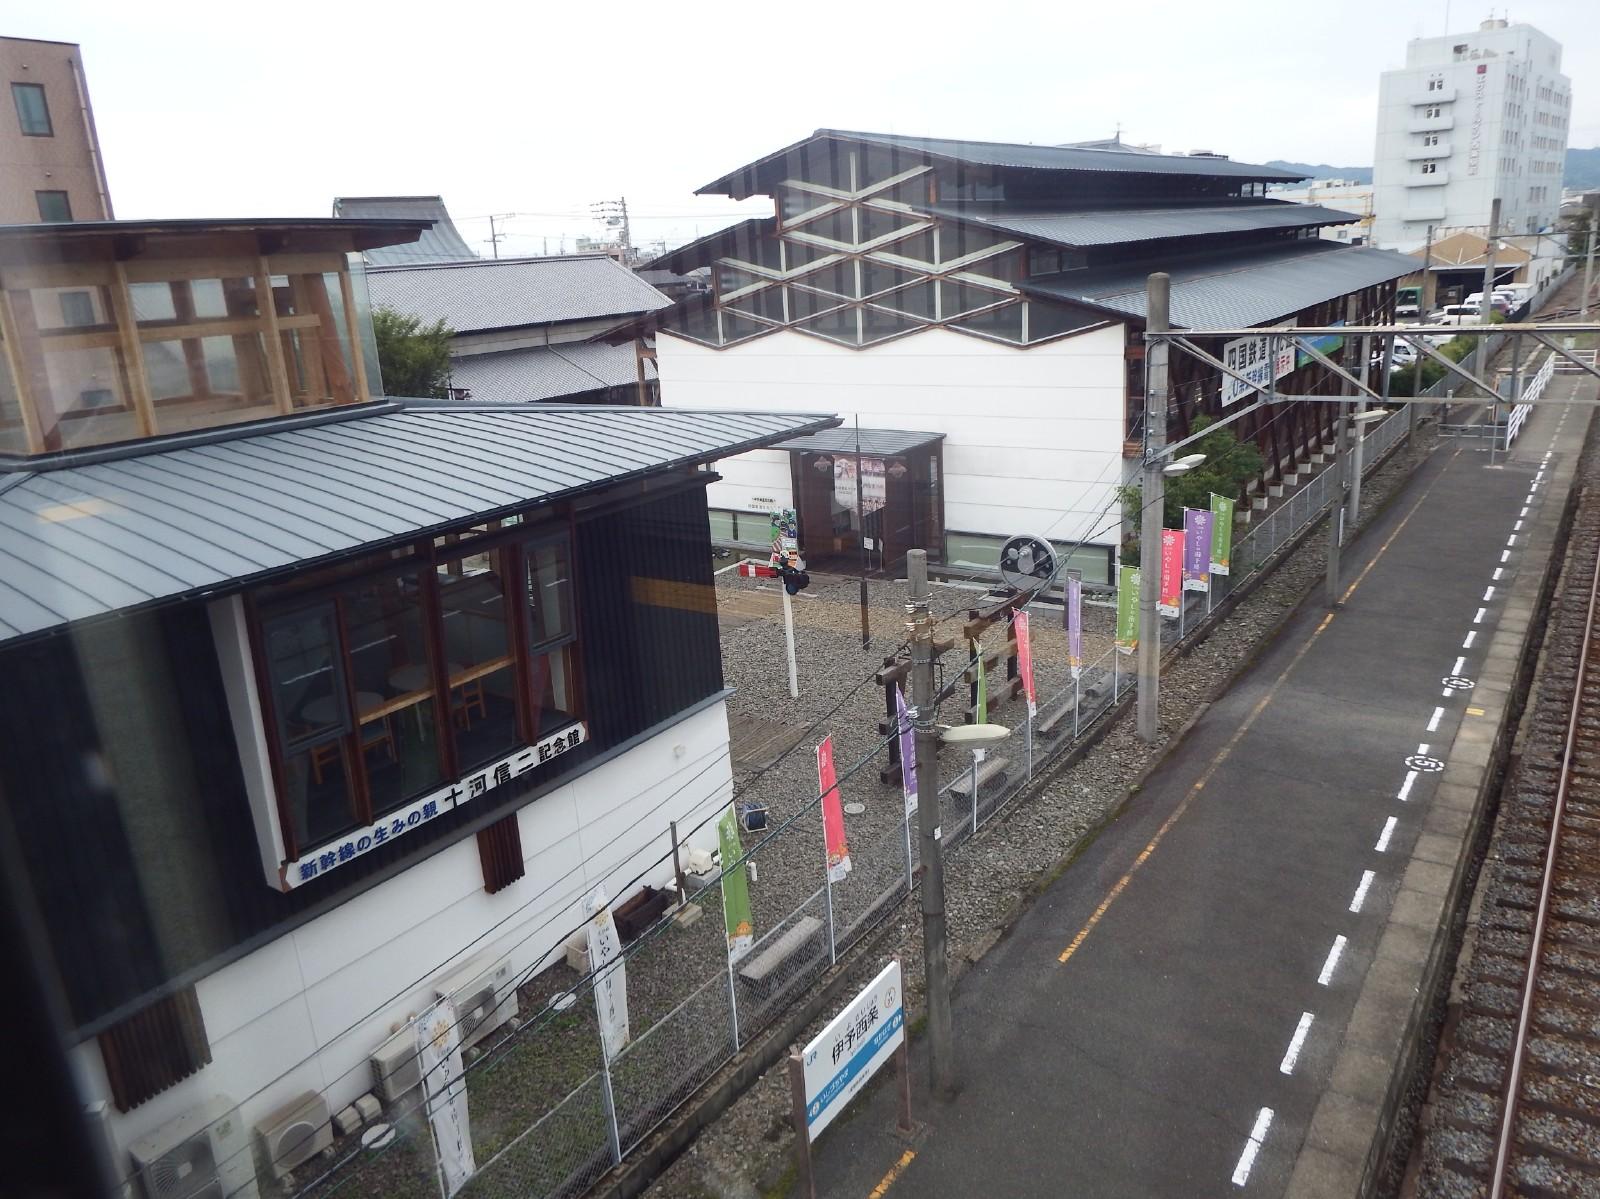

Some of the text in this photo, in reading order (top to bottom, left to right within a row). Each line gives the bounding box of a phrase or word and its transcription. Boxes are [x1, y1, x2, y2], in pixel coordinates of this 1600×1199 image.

[299, 728, 581, 881] 新幹線の生みの親 十河信二記念館
[806, 1051, 817, 1066] JR
[832, 1005, 879, 1065] 伊予西条
